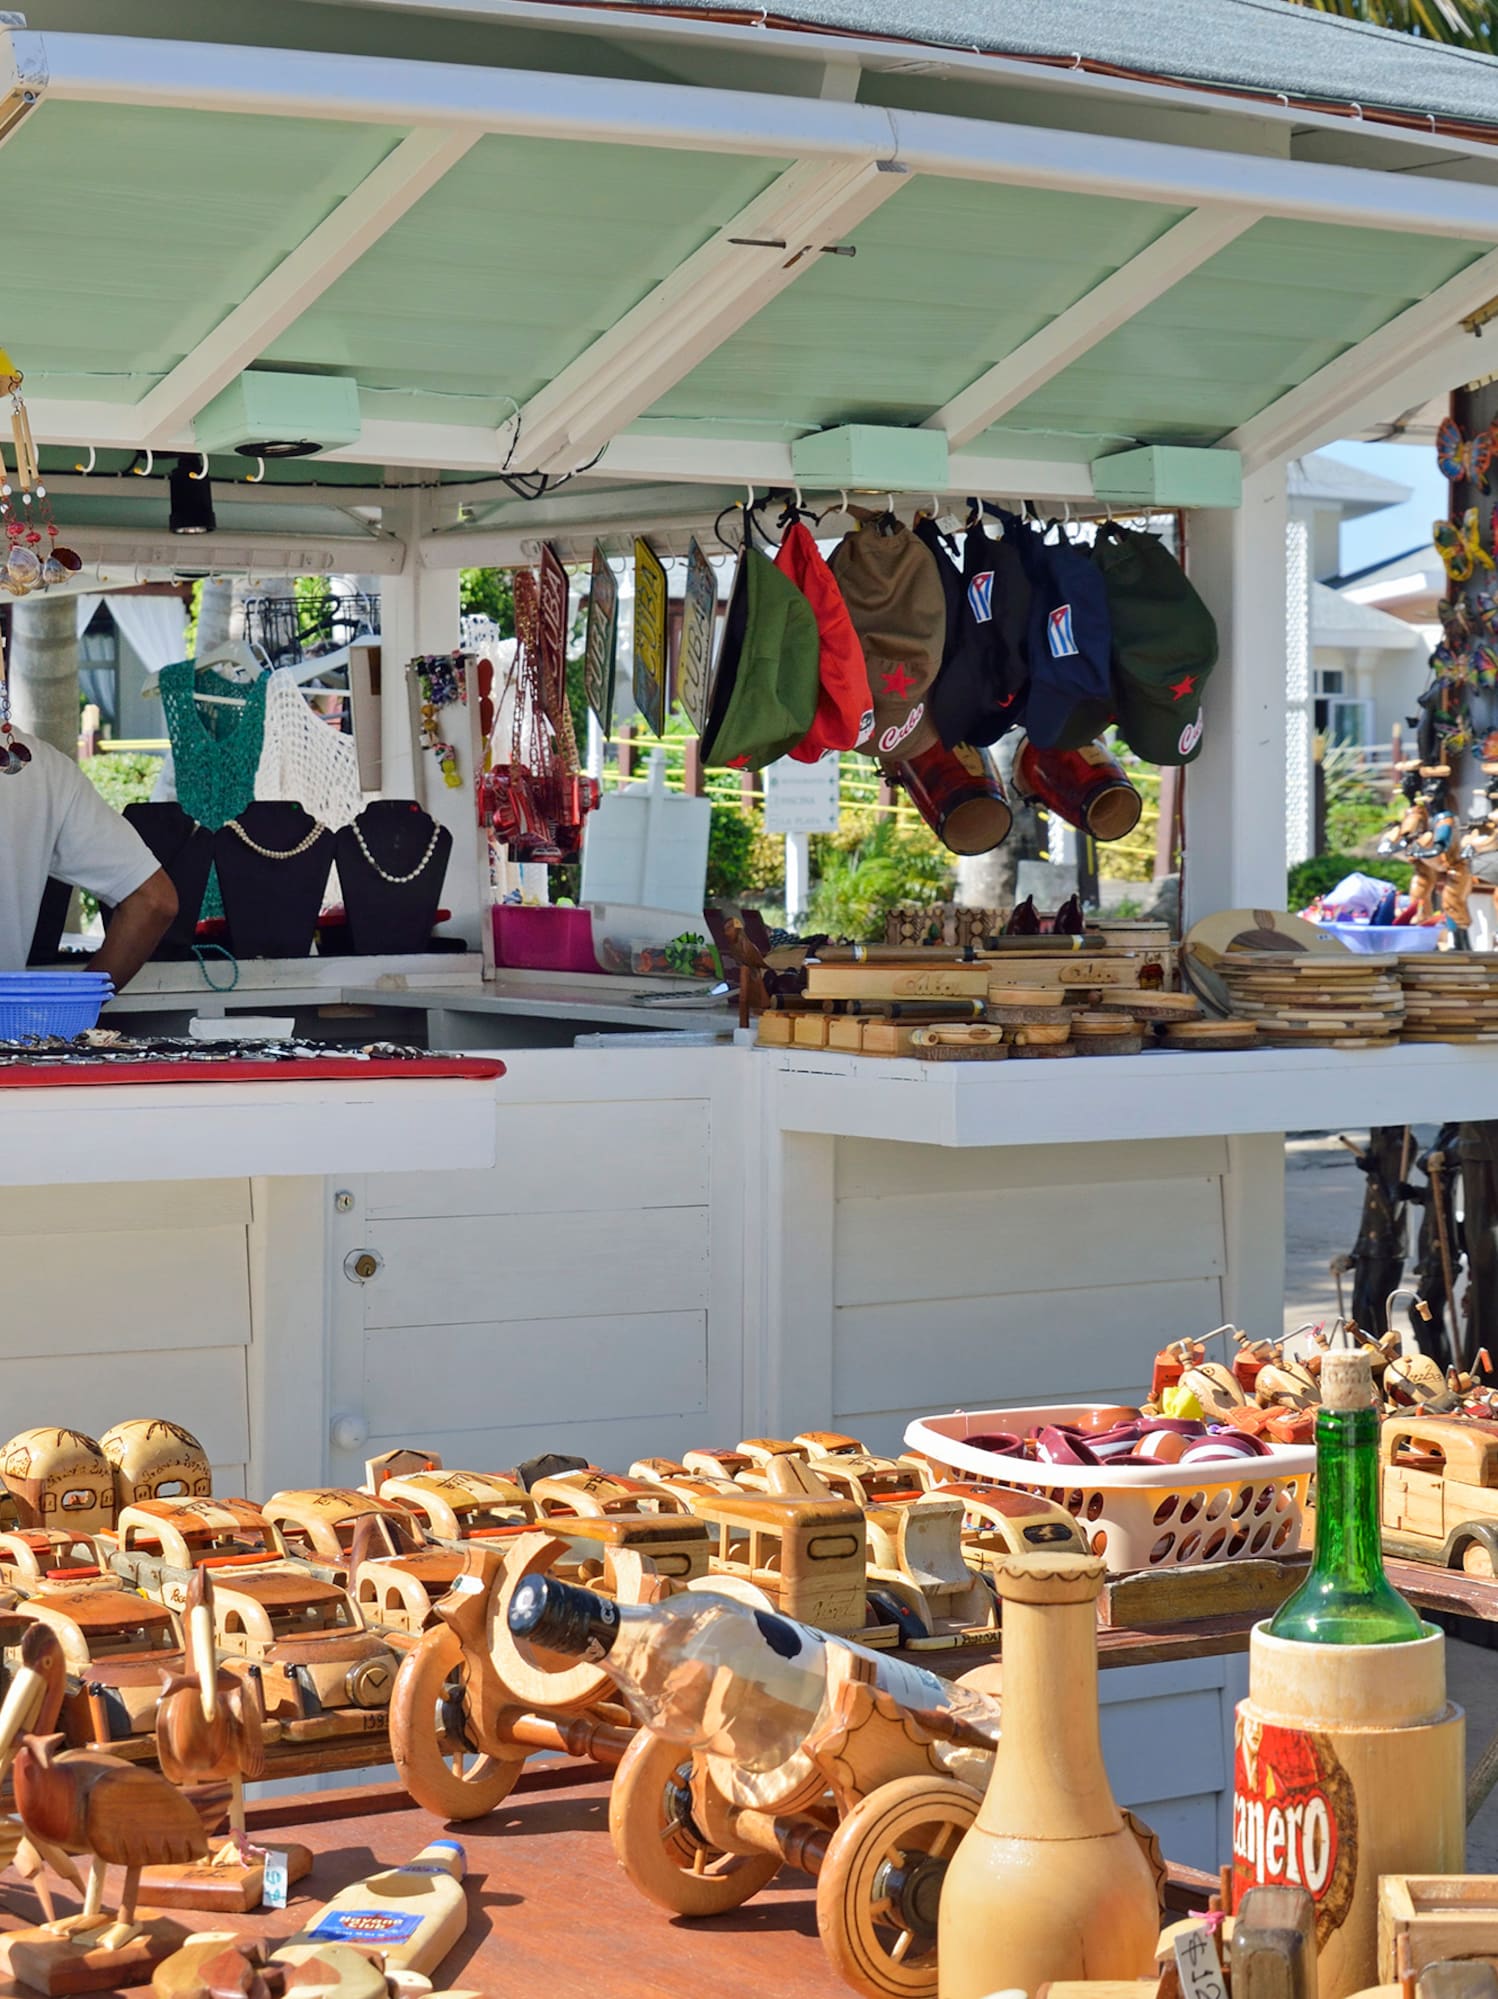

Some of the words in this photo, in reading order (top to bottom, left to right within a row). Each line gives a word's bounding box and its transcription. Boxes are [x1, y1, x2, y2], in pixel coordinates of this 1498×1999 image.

[542, 567, 562, 678] CUBA
[588, 602, 609, 712] CUBA
[682, 601, 709, 712] CUBA
[339, 1915, 403, 1925] Havana
[348, 1921, 386, 1929] Club
